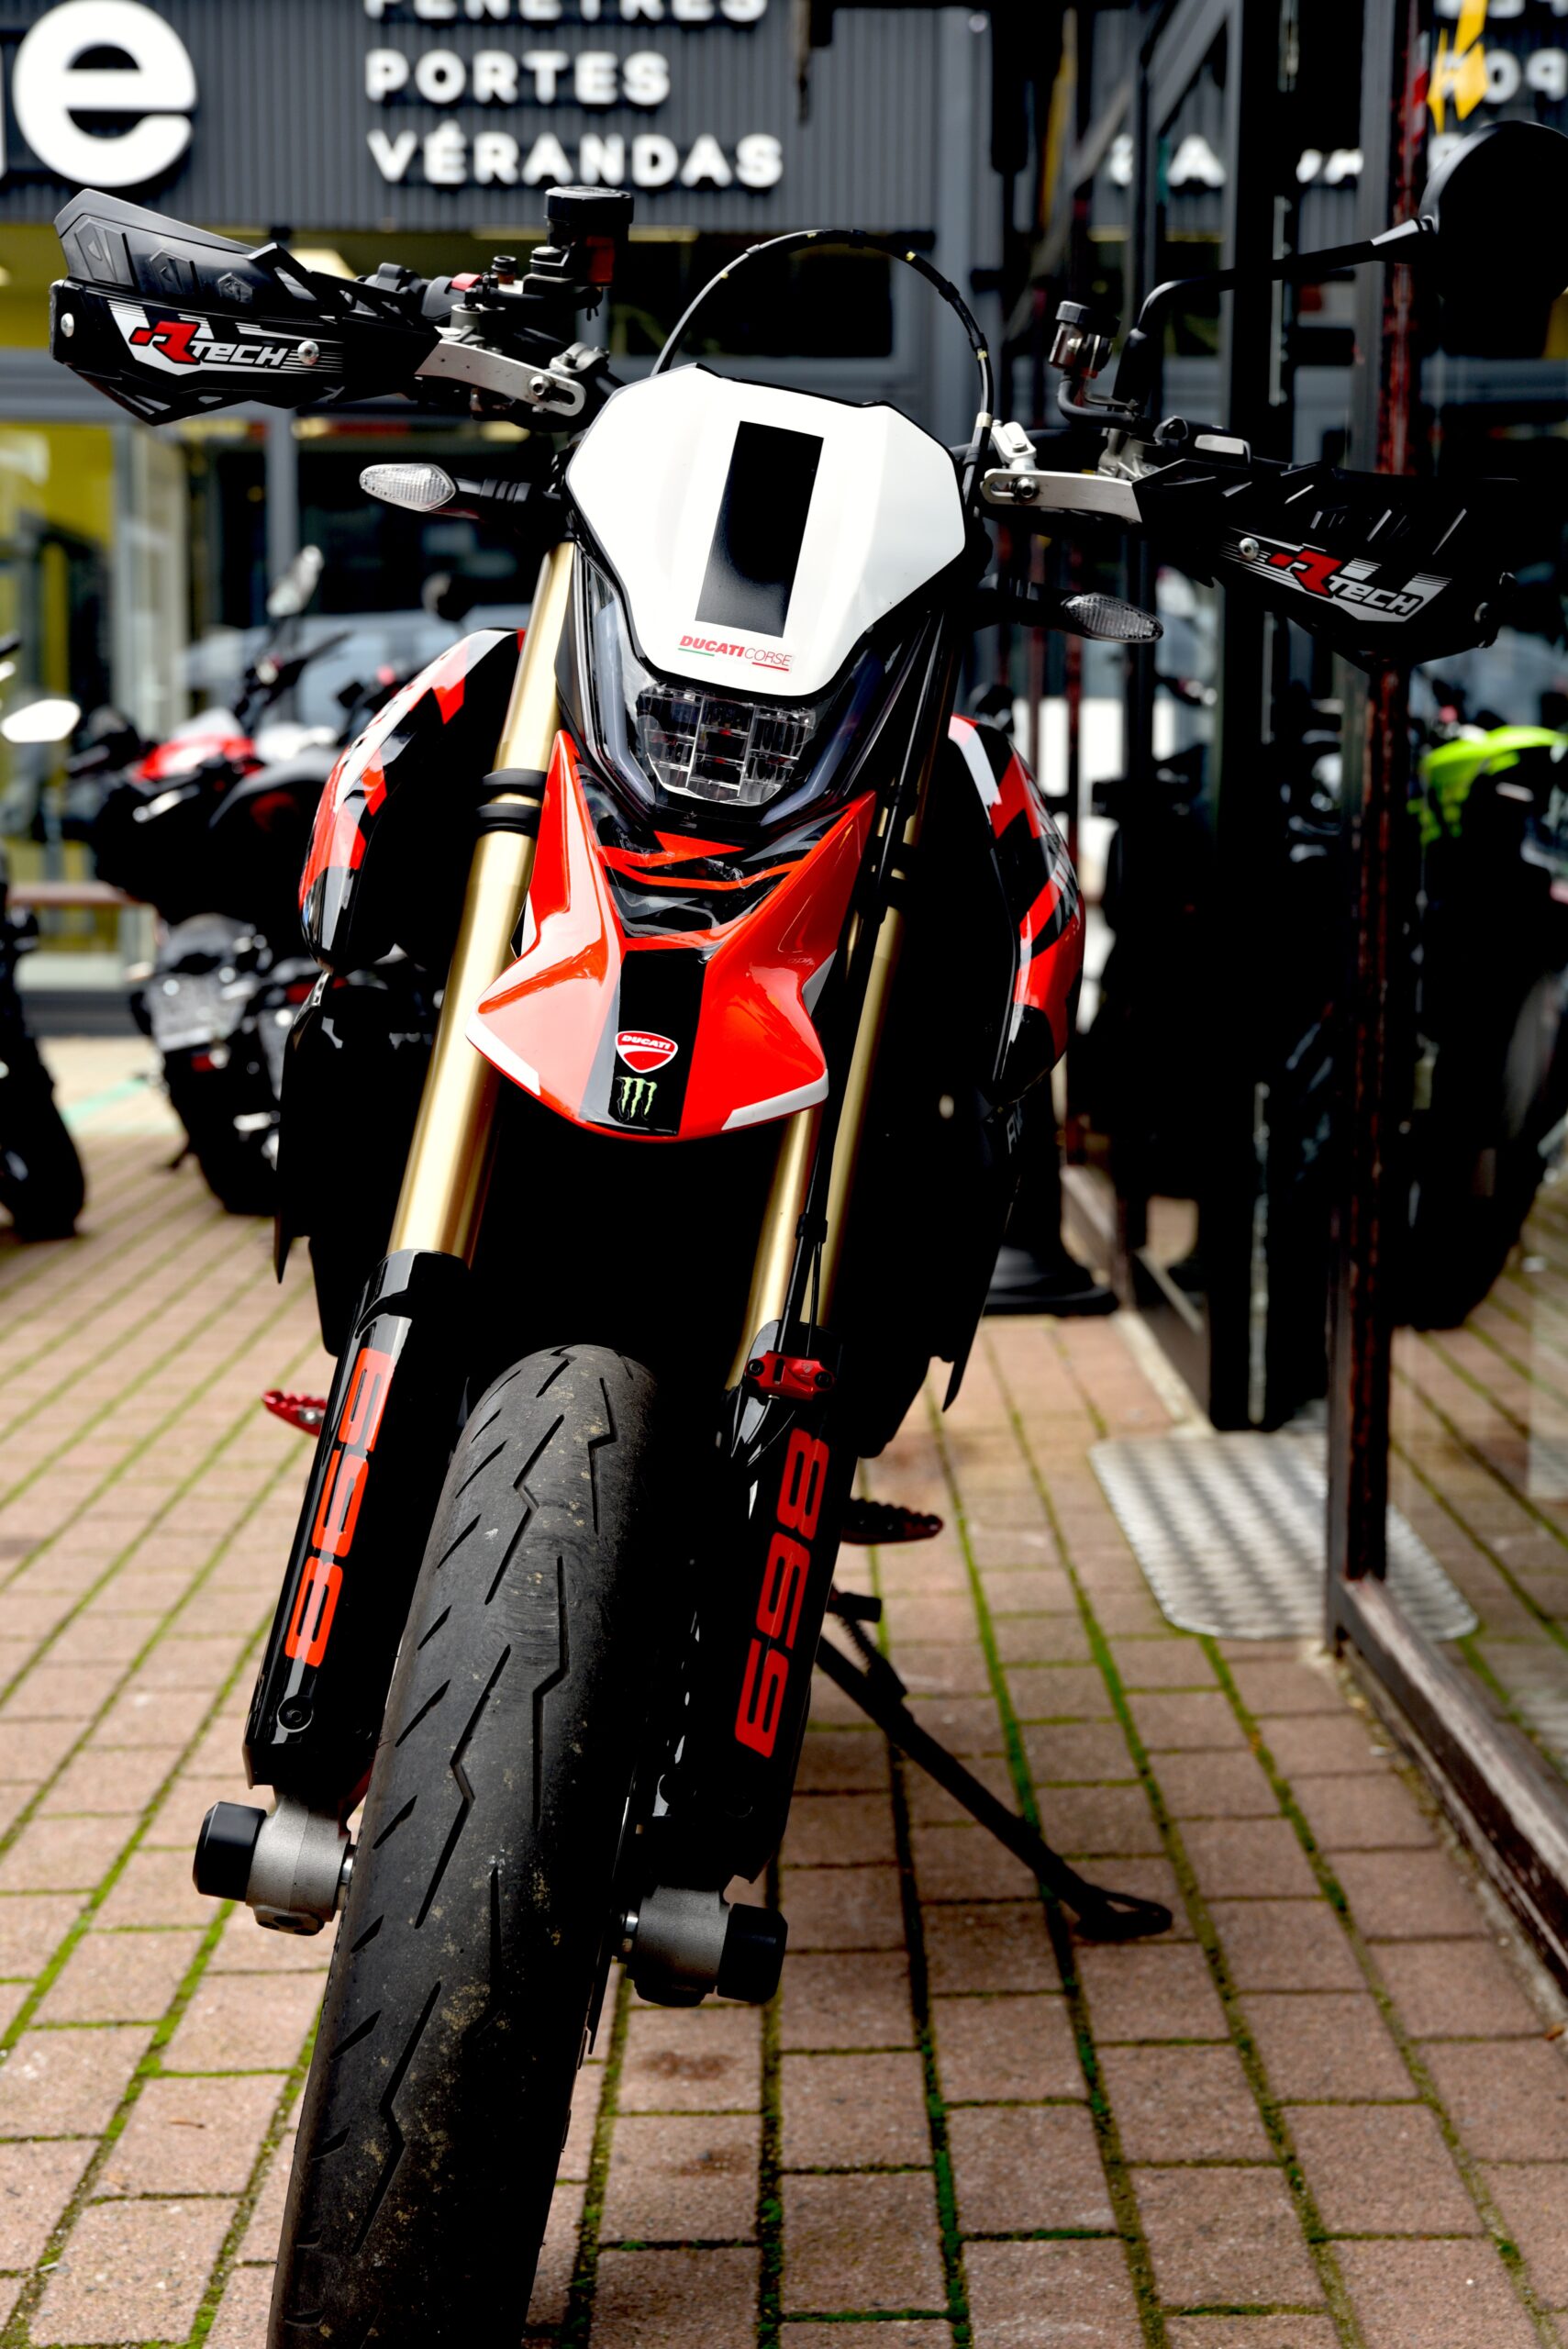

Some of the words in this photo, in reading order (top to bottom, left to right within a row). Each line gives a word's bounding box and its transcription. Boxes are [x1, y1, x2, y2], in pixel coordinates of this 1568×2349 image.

[0, 0, 197, 187] e
[366, 50, 670, 106] PORTES
[367, 120, 783, 187] VÉRANDAS
[621, 1035, 672, 1051] DUCATI
[284, 1347, 396, 1667] 698
[735, 1427, 829, 1759] 698
